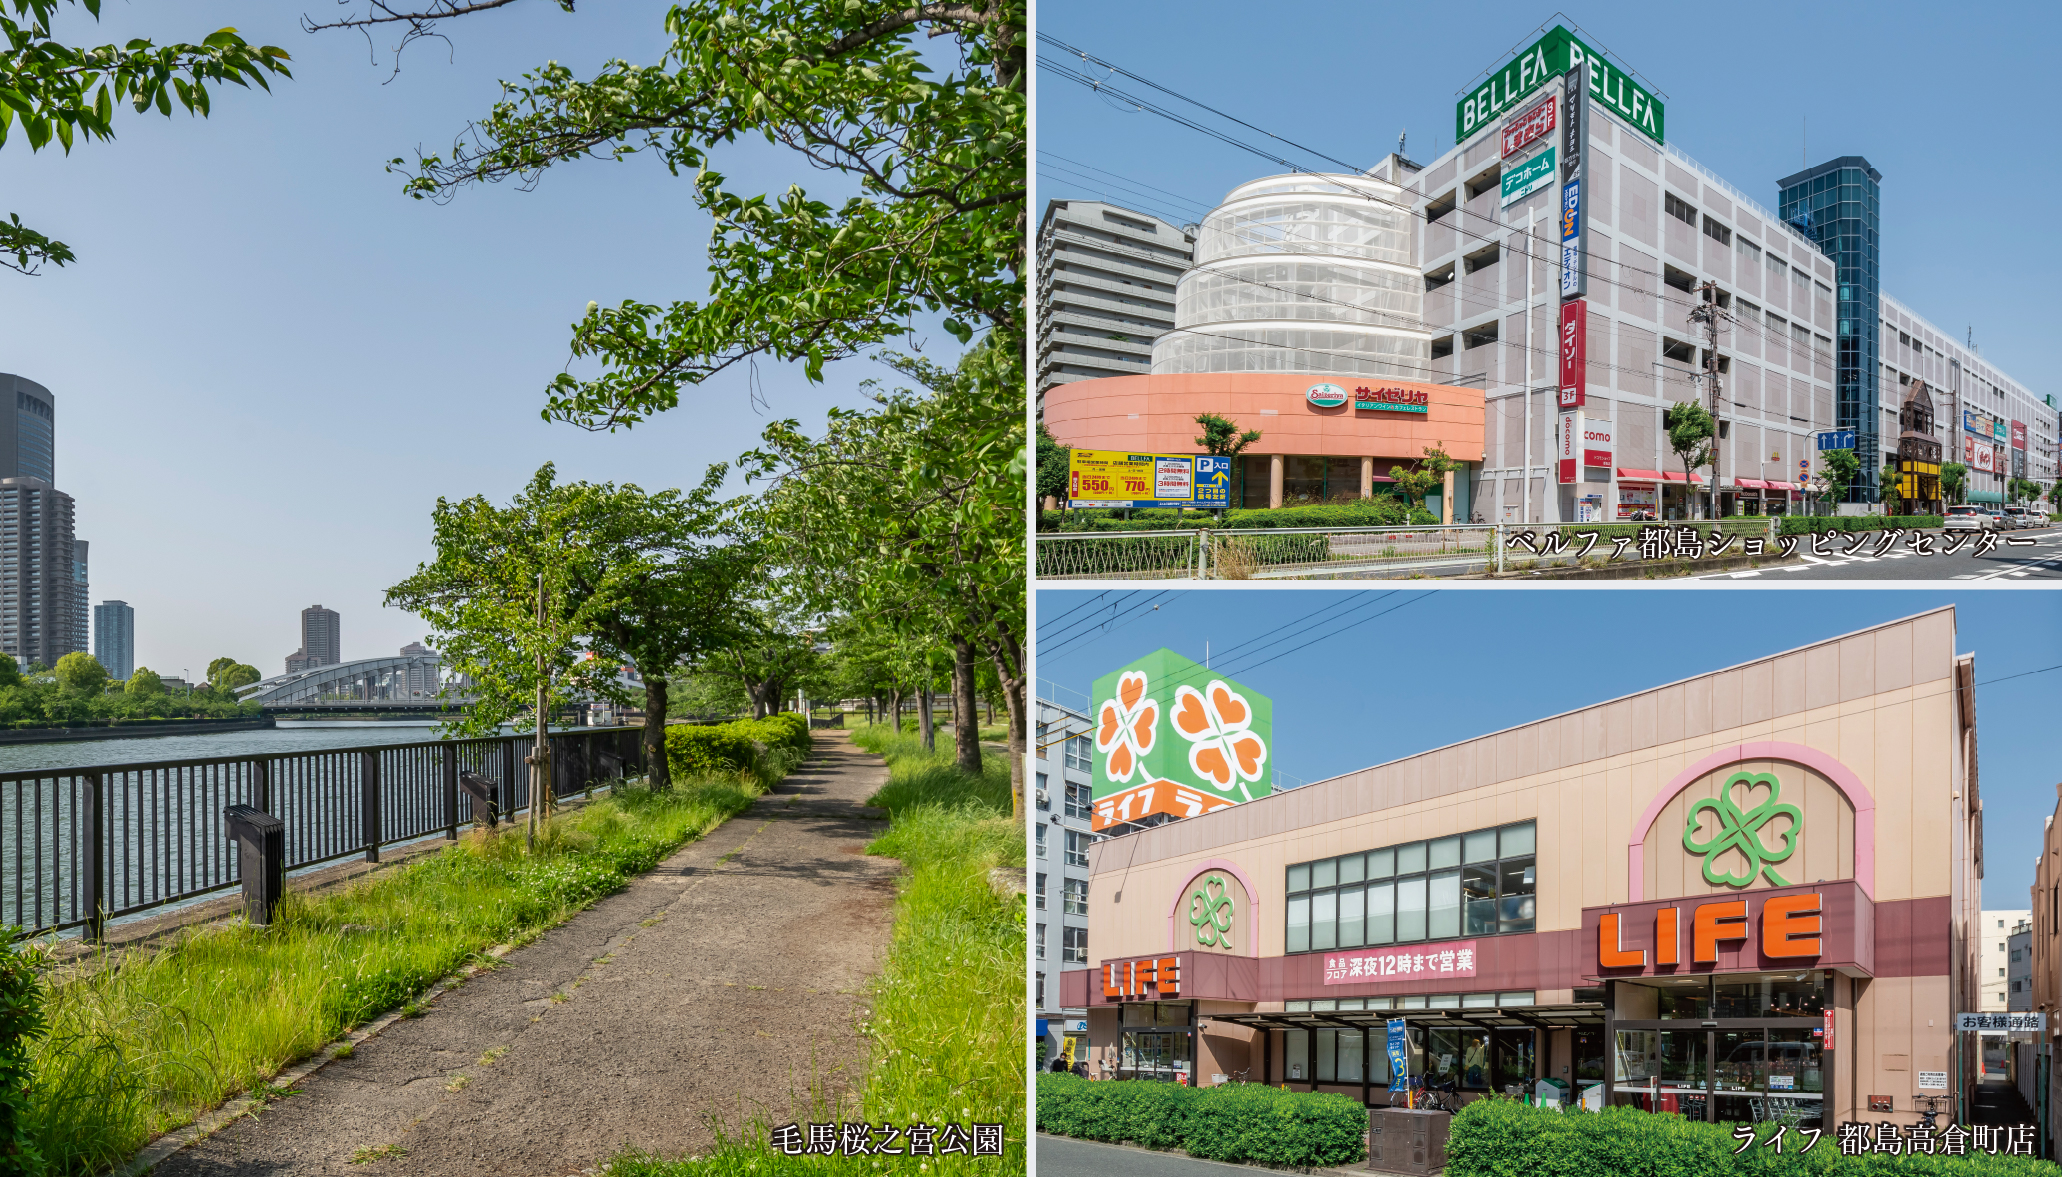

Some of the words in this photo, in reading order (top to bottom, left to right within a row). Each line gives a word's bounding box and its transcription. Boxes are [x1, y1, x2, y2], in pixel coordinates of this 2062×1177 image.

[1463, 44, 1548, 133] BELLFA
[1503, 115, 1546, 155] しまむら
[1505, 157, 1550, 192] デコホーム
[1520, 184, 1533, 197] ニトリ
[1563, 184, 1579, 237] EDION
[1564, 319, 1576, 369] ダイソー
[1355, 386, 1429, 404] サイゼリヤ
[1563, 390, 1575, 401] 3F
[1564, 416, 1572, 456] docomo
[1200, 459, 1210, 471] P
[1213, 462, 1229, 470] 入口
[1098, 787, 1155, 826] ライフ
[1175, 789, 1231, 818] ラ
[1599, 892, 1822, 968] LIFE
[1103, 956, 1181, 997] LIFE
[1326, 969, 1348, 980] フロア
[1328, 957, 1346, 969] 食品
[1349, 948, 1474, 977] 深夜12時まで営業
[1962, 1015, 2040, 1029] お客様通路
